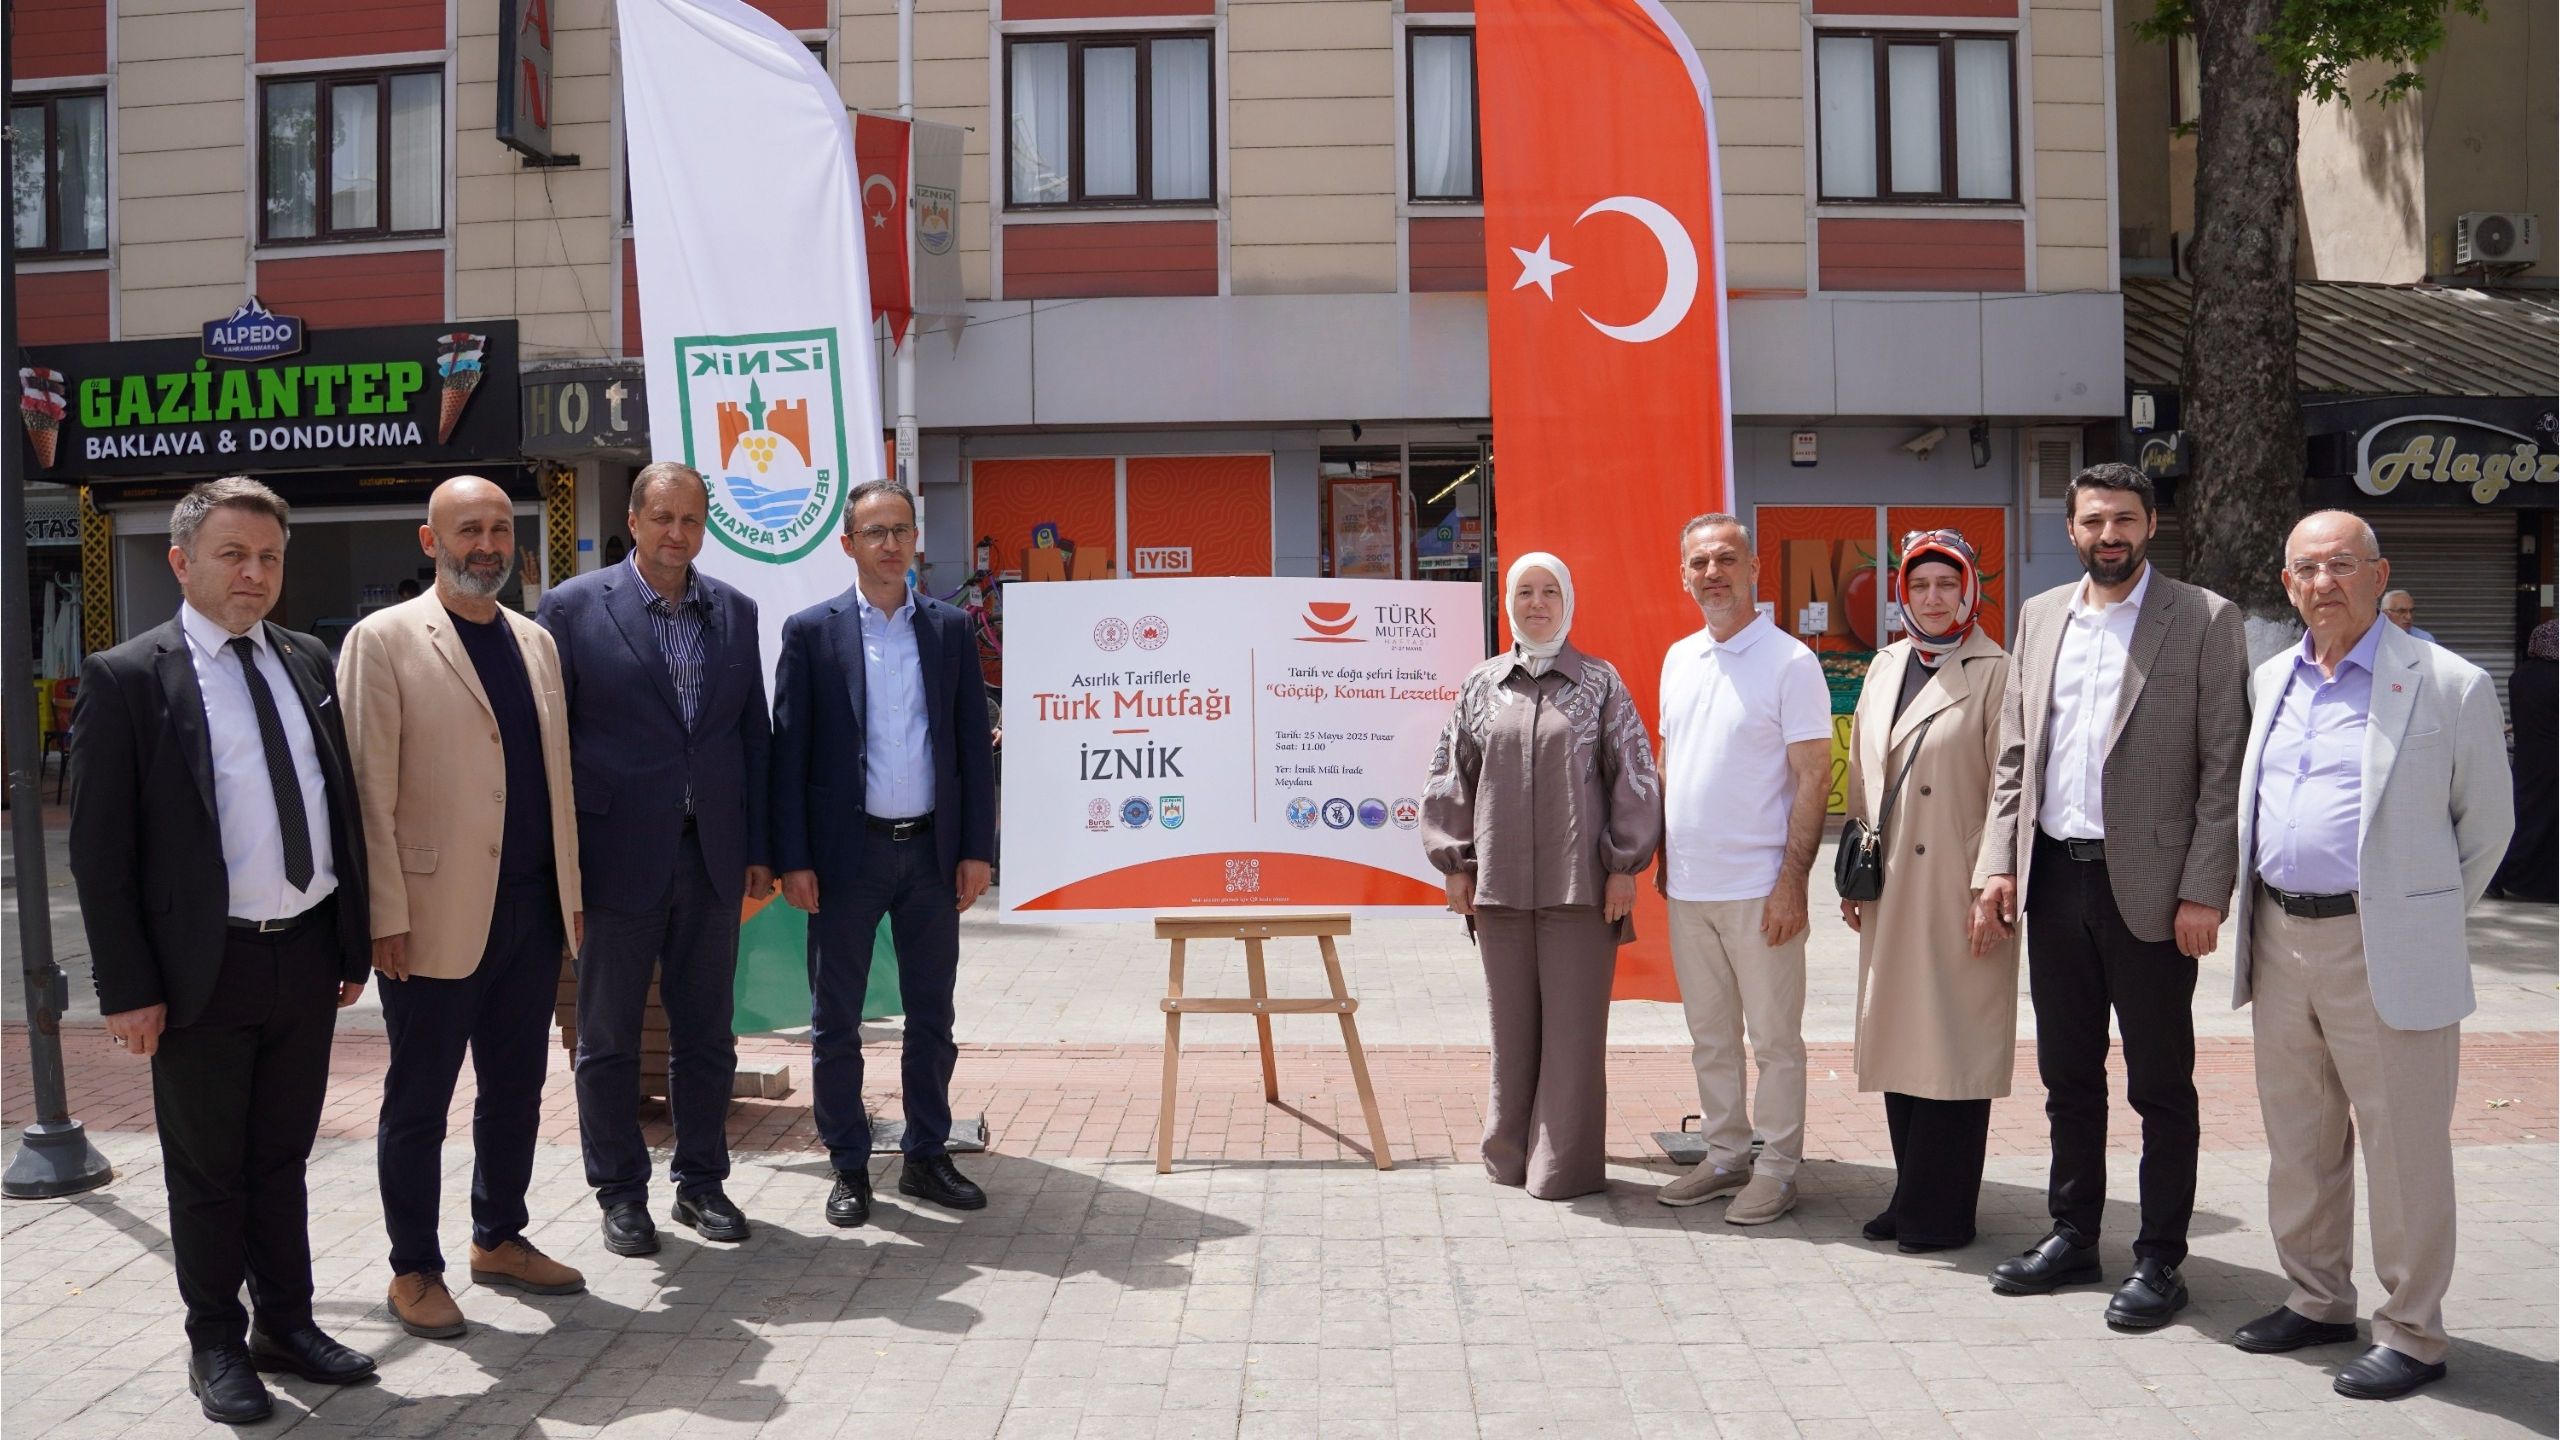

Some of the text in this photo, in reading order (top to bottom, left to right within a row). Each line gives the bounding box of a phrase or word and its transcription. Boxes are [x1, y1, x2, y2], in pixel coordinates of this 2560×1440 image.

[211, 324, 292, 345] ALPEDO
[80, 358, 423, 428] GAZİANTEP
[86, 421, 423, 460] BAKLAVA & DONDURMA
[2370, 435, 2559, 504] Alagöz
[1374, 603, 1436, 625] TÜRK
[1375, 625, 1436, 639] MUTFAĞI
[1071, 669, 1191, 687] Asırlık Tariflerle
[1287, 667, 1437, 683] Tarih ve doğa şehri İznik'te
[1334, 685, 1385, 700] Konan
[1390, 685, 1460, 701] Lezzetler
[1033, 687, 1231, 721] Türk Mutfağı
[1275, 729, 1396, 744] Tarih: 25 Mayıs 2025 Pazar
[1275, 742, 1326, 751] Saat: 11.00
[1080, 740, 1184, 781] İZNİK
[1275, 763, 1363, 775] Yer: İznik Milli İrade
[1275, 777, 1313, 790] Meydanı
